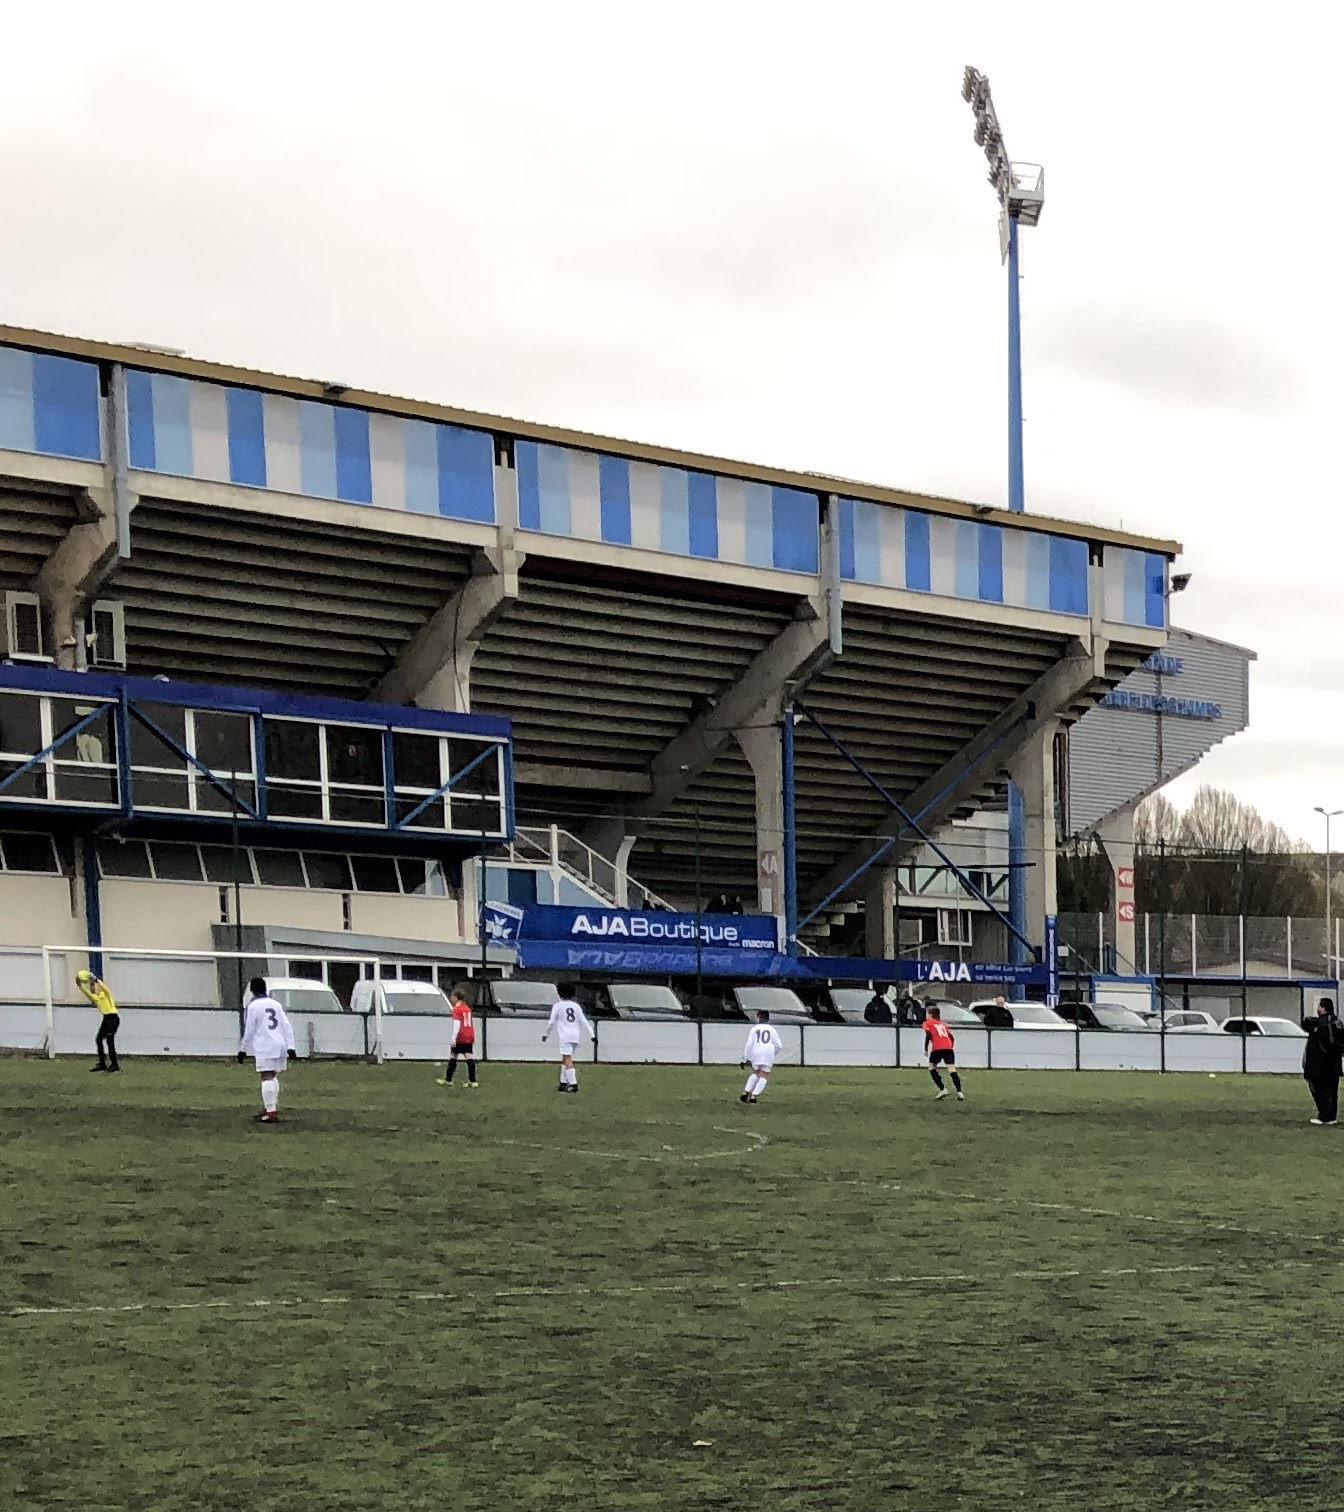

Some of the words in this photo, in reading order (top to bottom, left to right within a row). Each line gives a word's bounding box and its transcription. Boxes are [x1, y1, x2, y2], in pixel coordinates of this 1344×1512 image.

[265, 1008, 279, 1031] 3
[566, 1007, 576, 1023] 8
[755, 1029, 771, 1045] 10
[934, 1023, 949, 1038] 10
